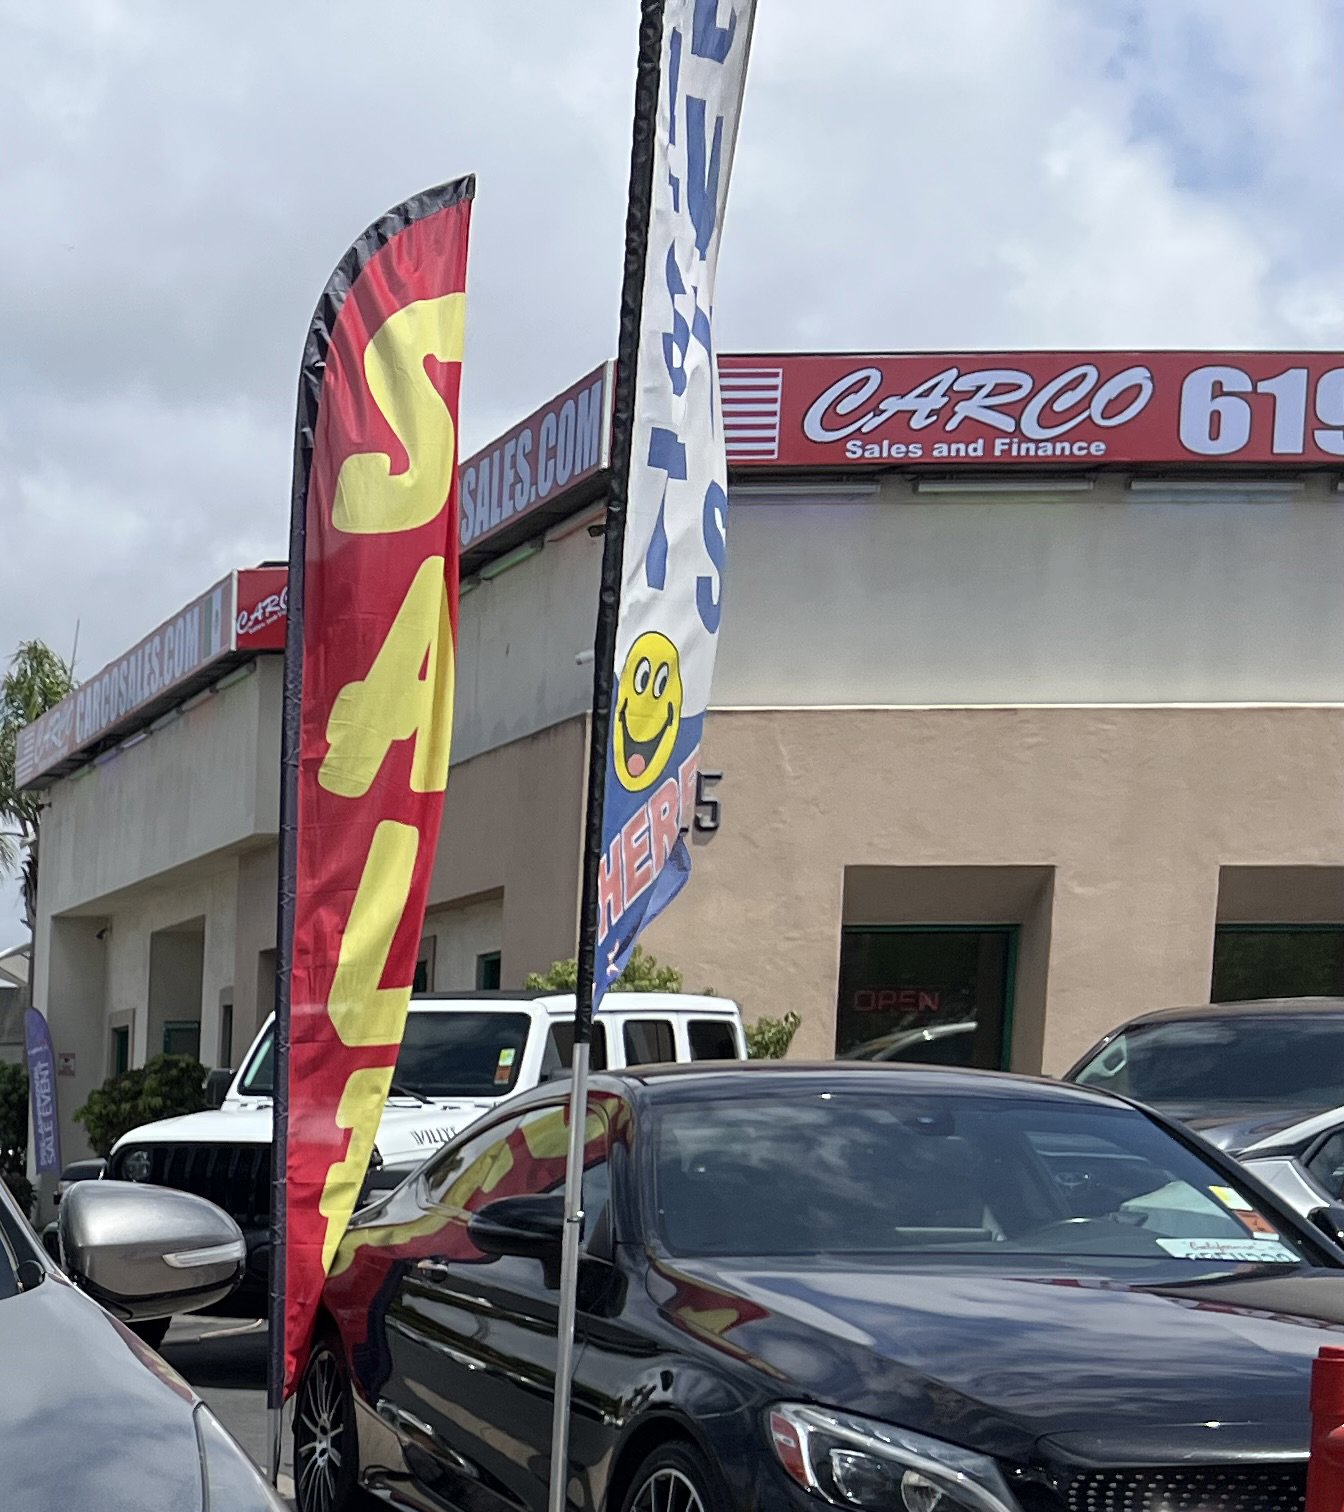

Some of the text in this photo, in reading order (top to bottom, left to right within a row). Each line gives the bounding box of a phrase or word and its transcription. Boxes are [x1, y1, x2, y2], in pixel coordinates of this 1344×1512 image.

[803, 364, 1154, 443] CARCO
[458, 379, 603, 547] SALES.COM
[845, 437, 1106, 459] Sales and Finance
[75, 606, 201, 744] CARCOSALES.COM
[854, 990, 940, 1012] OPEN
